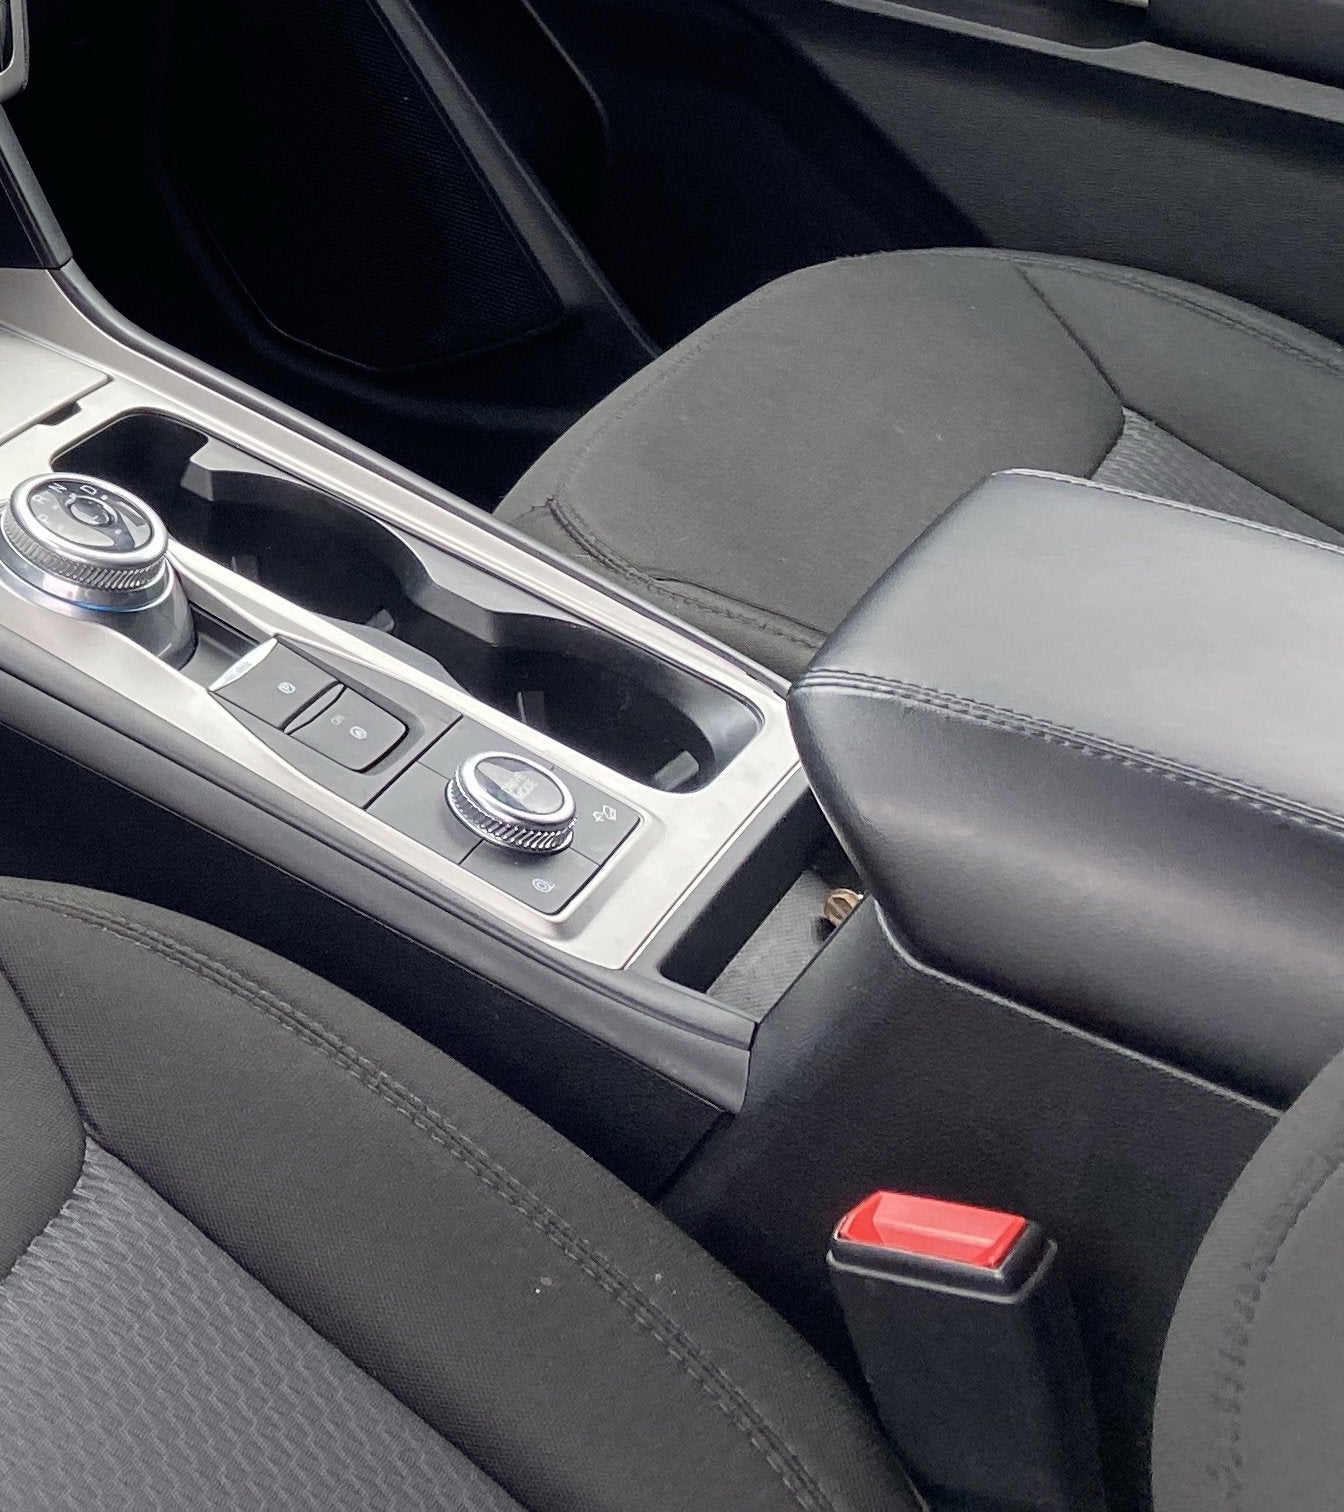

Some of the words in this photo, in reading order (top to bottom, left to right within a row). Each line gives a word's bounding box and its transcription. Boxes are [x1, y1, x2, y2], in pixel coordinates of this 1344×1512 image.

[47, 482, 68, 494] N
[79, 484, 98, 496] D
[31, 494, 51, 505] R
